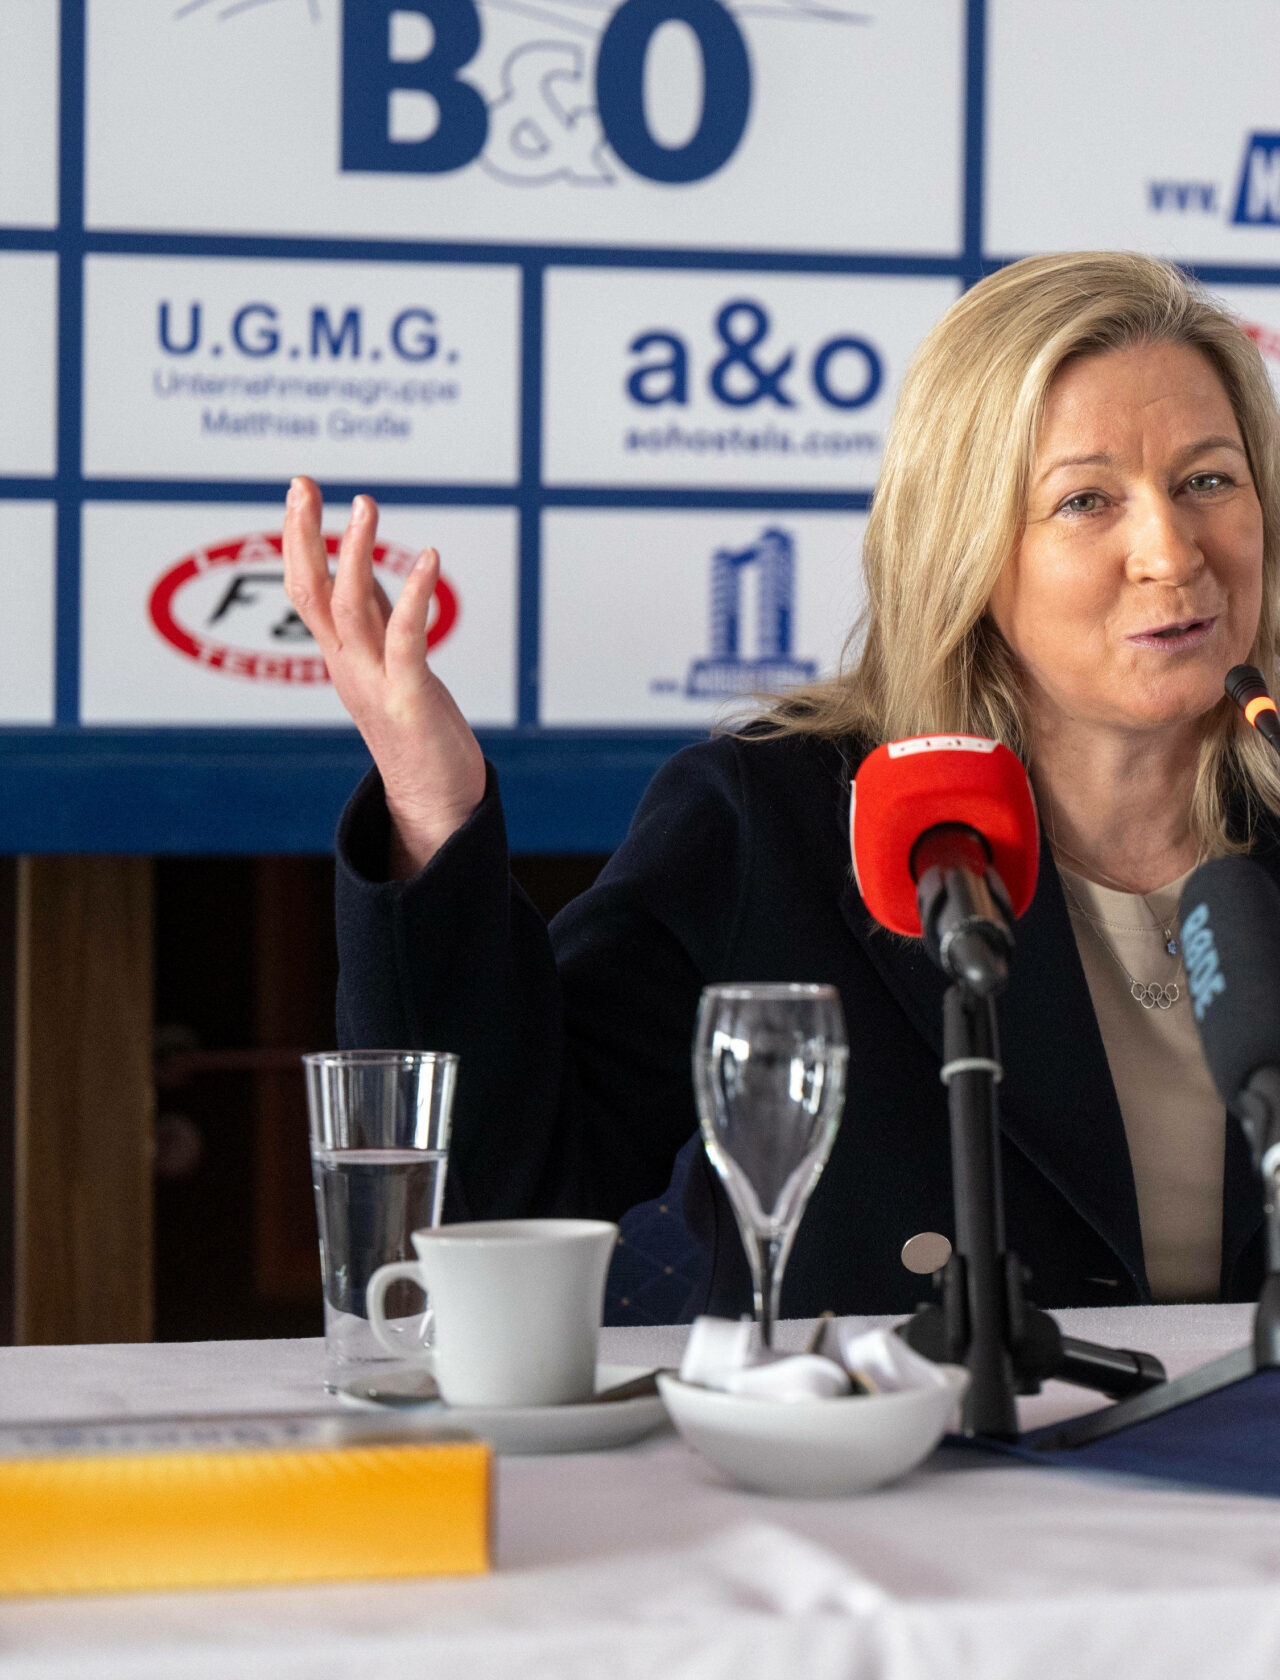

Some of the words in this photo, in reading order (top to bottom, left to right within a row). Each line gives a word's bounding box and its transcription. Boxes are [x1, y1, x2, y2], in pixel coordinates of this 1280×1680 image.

[156, 300, 461, 363] U.G.M.G.
[626, 297, 884, 411] a&o
[153, 368, 460, 407] Unternehmensgruppe
